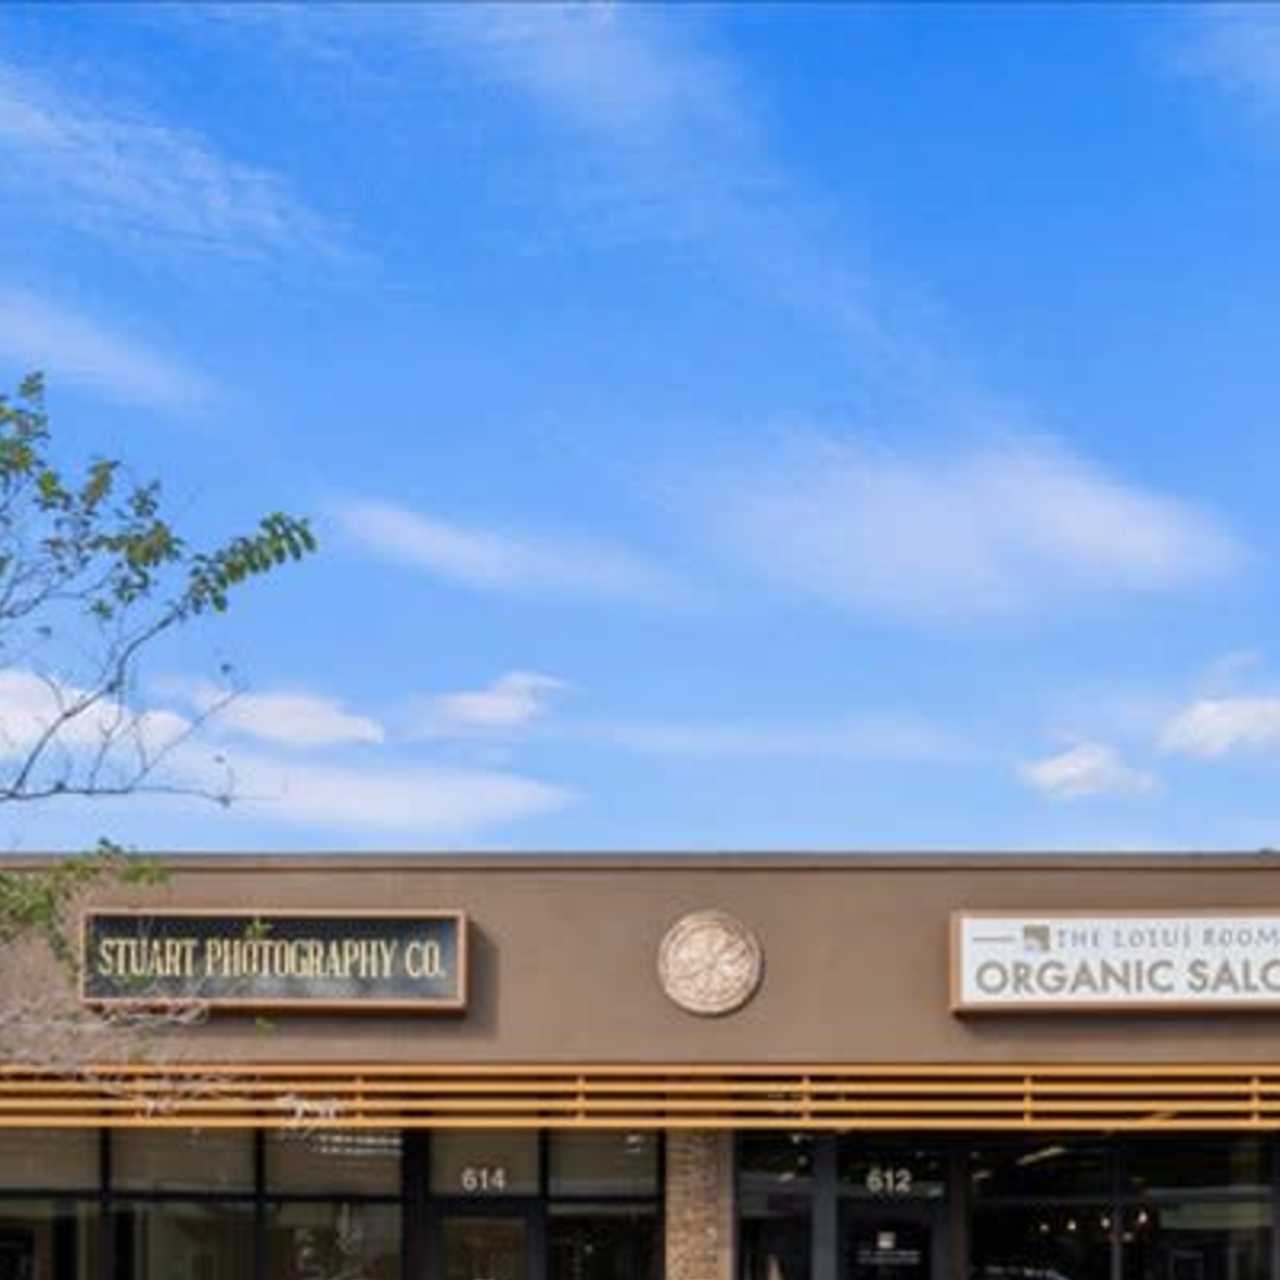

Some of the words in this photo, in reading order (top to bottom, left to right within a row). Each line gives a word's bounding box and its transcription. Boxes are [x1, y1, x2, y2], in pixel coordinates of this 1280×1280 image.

[1057, 928, 1101, 949] THE
[1113, 926, 1191, 949] LOTUS
[1202, 925, 1280, 948] ROOM
[98, 938, 199, 978] STUART
[207, 938, 398, 979] PHOTOGRAPHY
[405, 940, 446, 978] CO.
[975, 960, 1176, 995] ORGANIC
[462, 1168, 507, 1191] 614
[866, 1167, 913, 1193] 612
